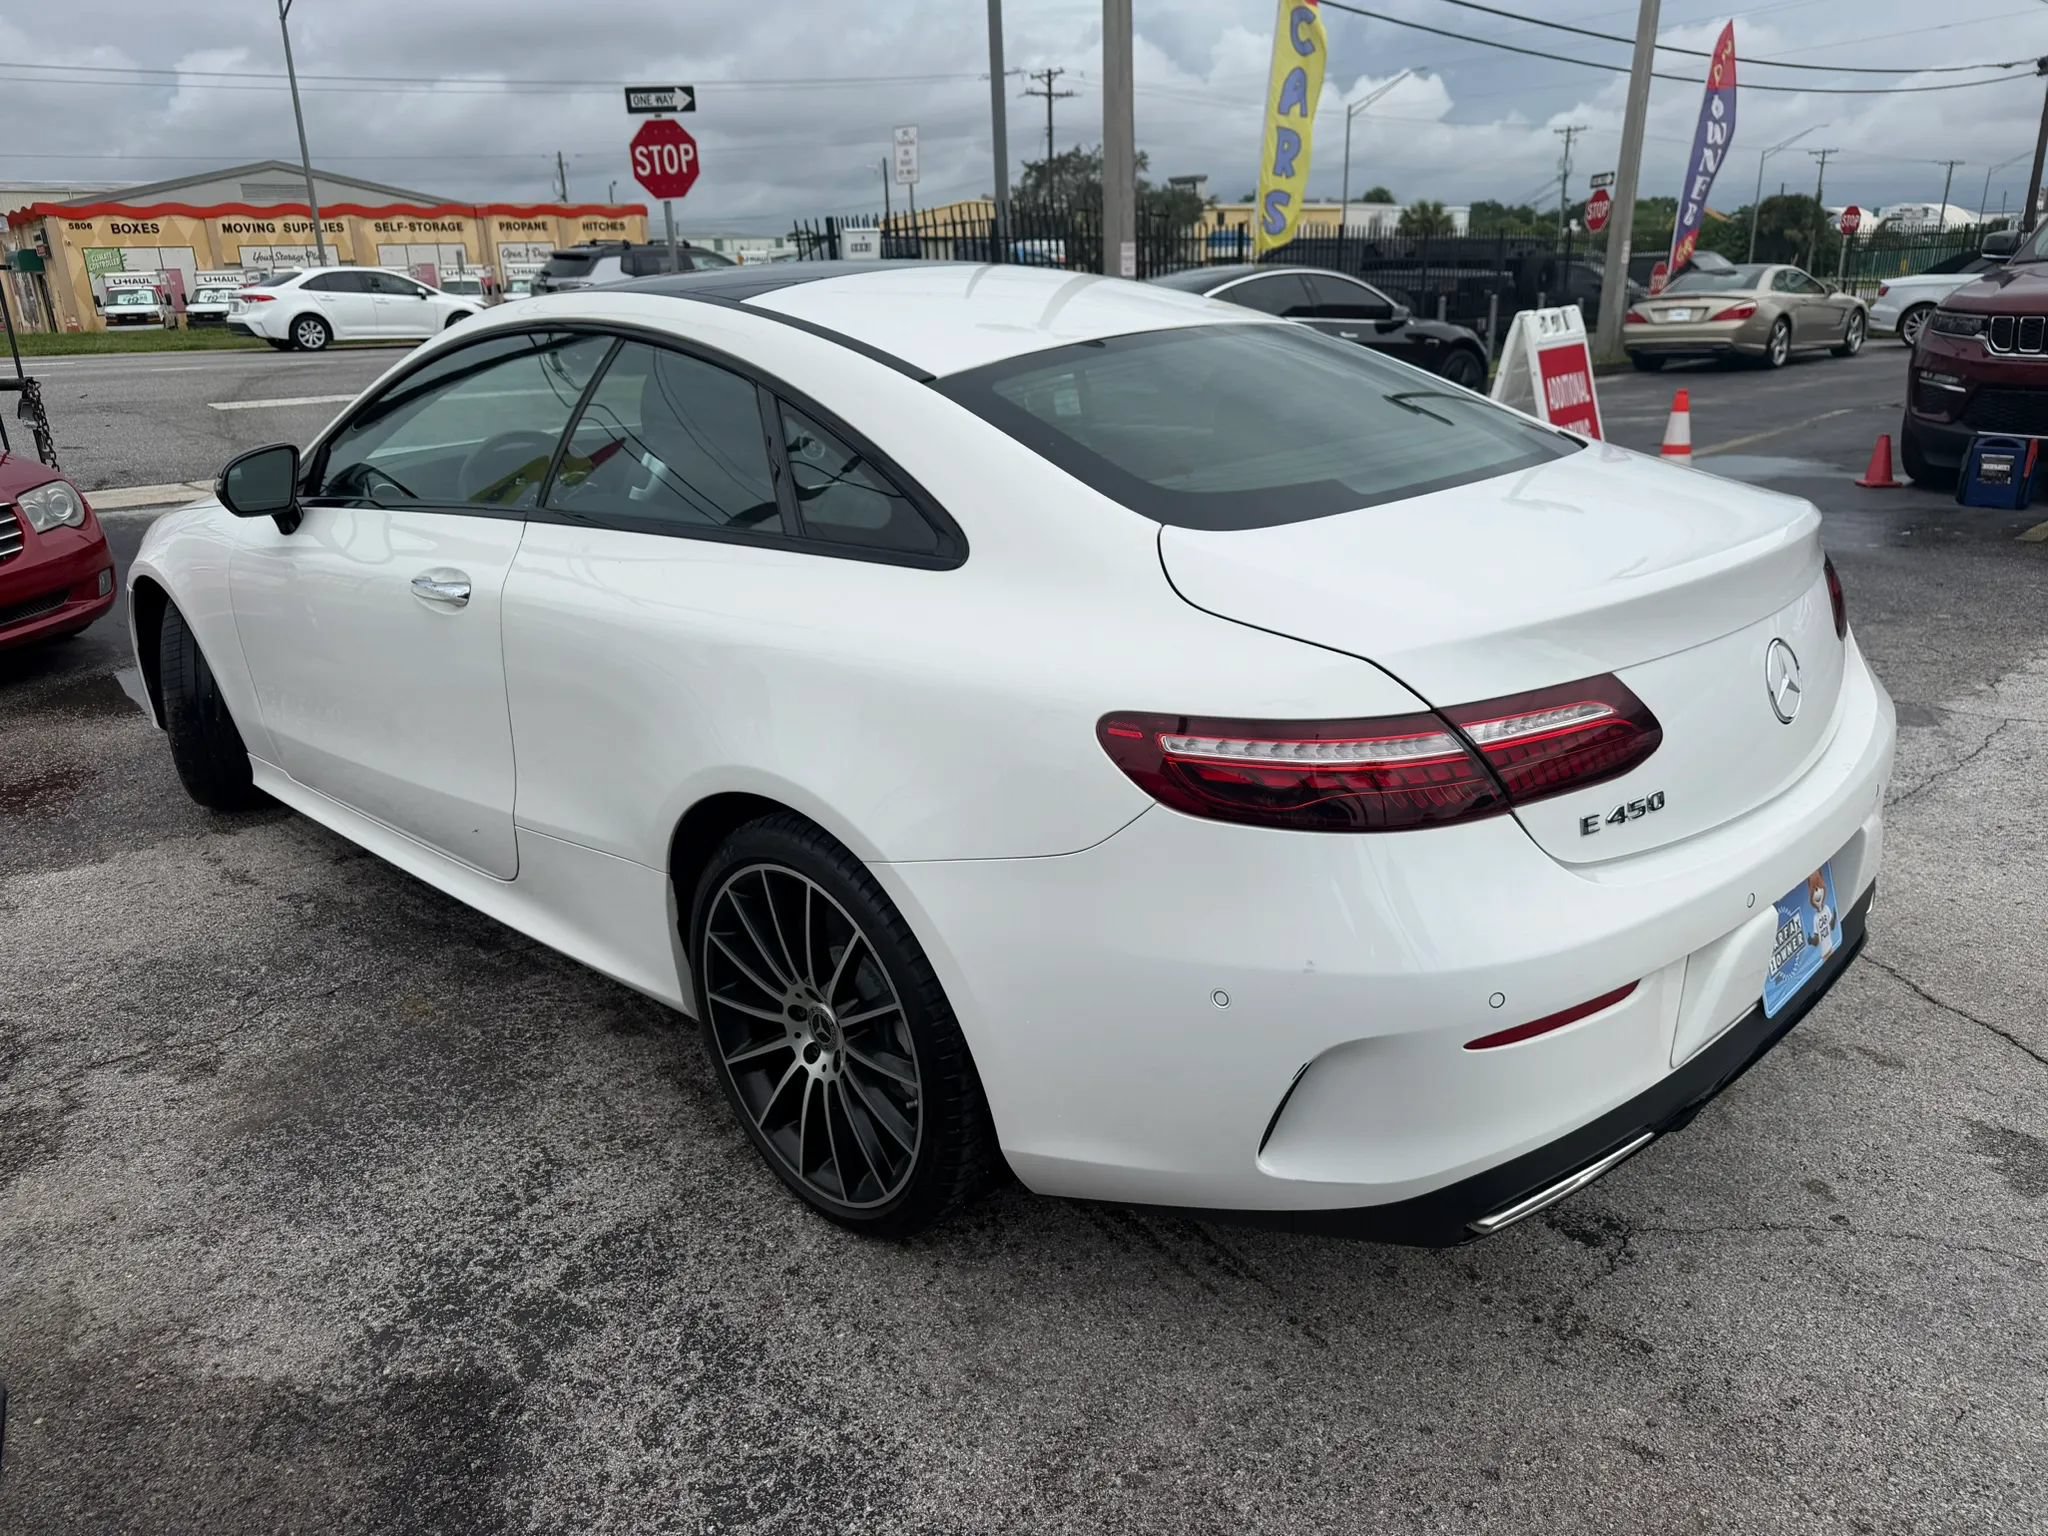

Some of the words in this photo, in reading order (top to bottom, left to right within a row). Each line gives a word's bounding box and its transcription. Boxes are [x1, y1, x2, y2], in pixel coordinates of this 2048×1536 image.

[632, 95, 652, 106] ONE
[654, 95, 674, 105] WAY
[1262, 5, 1316, 235] CARS
[635, 144, 695, 177] STOP
[1588, 200, 1609, 220] STOP
[68, 222, 93, 230] 5806
[110, 223, 160, 234] BOXES
[222, 222, 276, 233] MOVING
[374, 221, 464, 233] SELF-STORAGE
[499, 221, 548, 232] PROPANE
[582, 221, 626, 232] HITCHES
[1840, 214, 1860, 228] STOP
[1546, 371, 1591, 411] ADDITIONAL
[1579, 814, 1601, 837] E
[1605, 790, 1665, 825] 450
[1818, 914, 1828, 929] CAR
[1820, 927, 1829, 941] FOX
